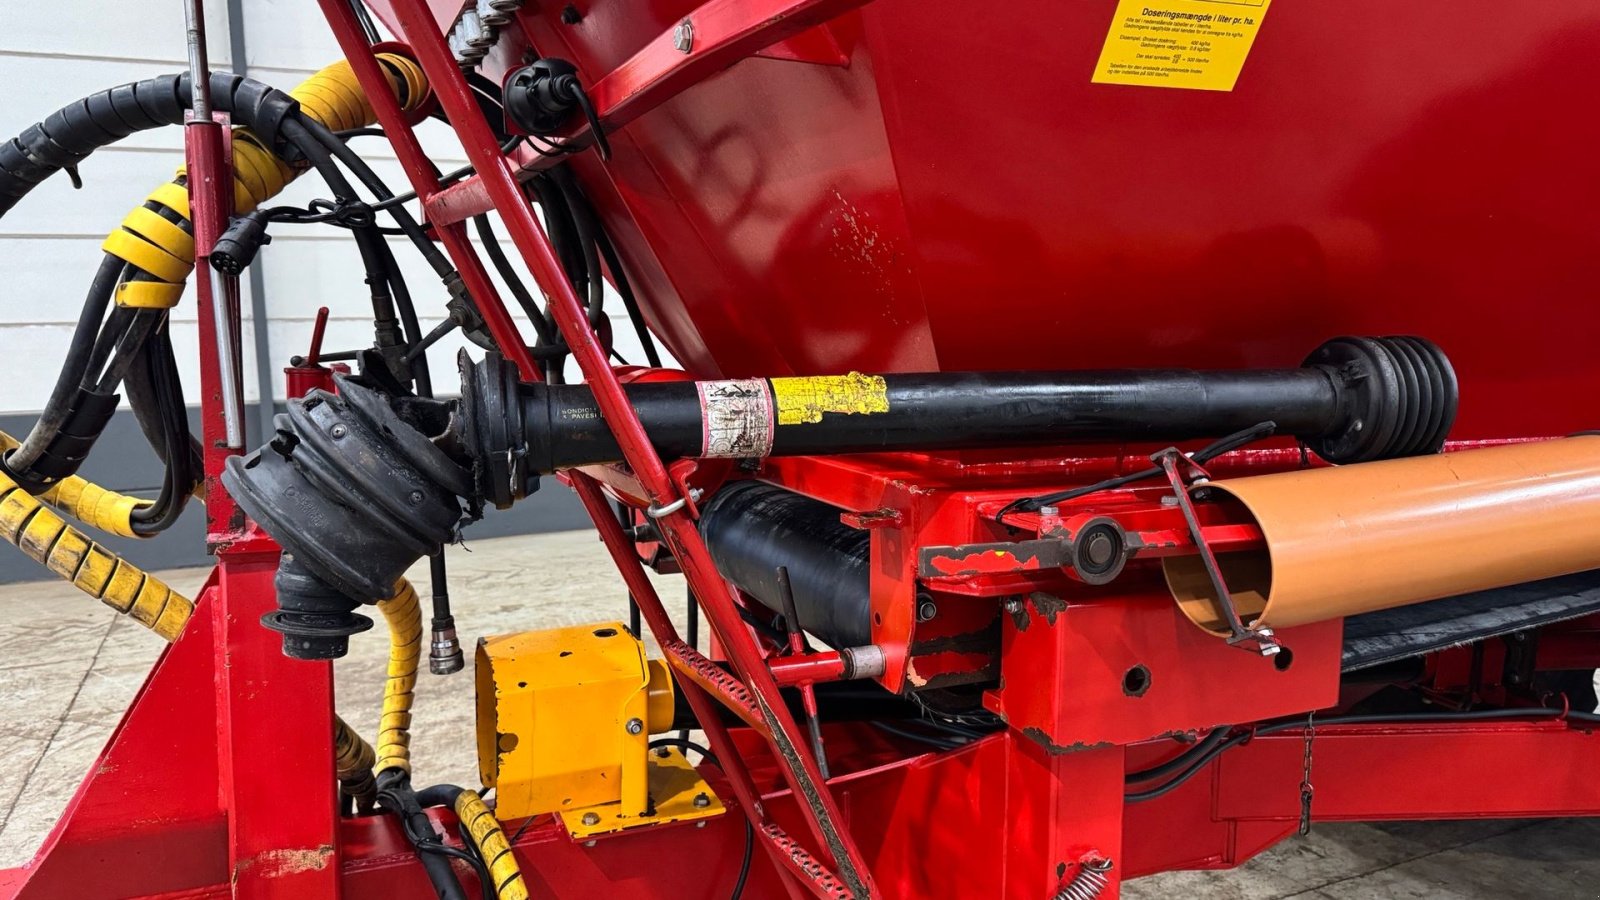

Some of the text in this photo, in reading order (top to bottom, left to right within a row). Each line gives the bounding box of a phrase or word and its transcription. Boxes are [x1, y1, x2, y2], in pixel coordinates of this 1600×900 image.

[1142, 7, 1212, 22] Doseringsmængde
[1217, 14, 1232, 23] liter
[1232, 17, 1242, 25] pr.
[1244, 17, 1255, 25] ha.
